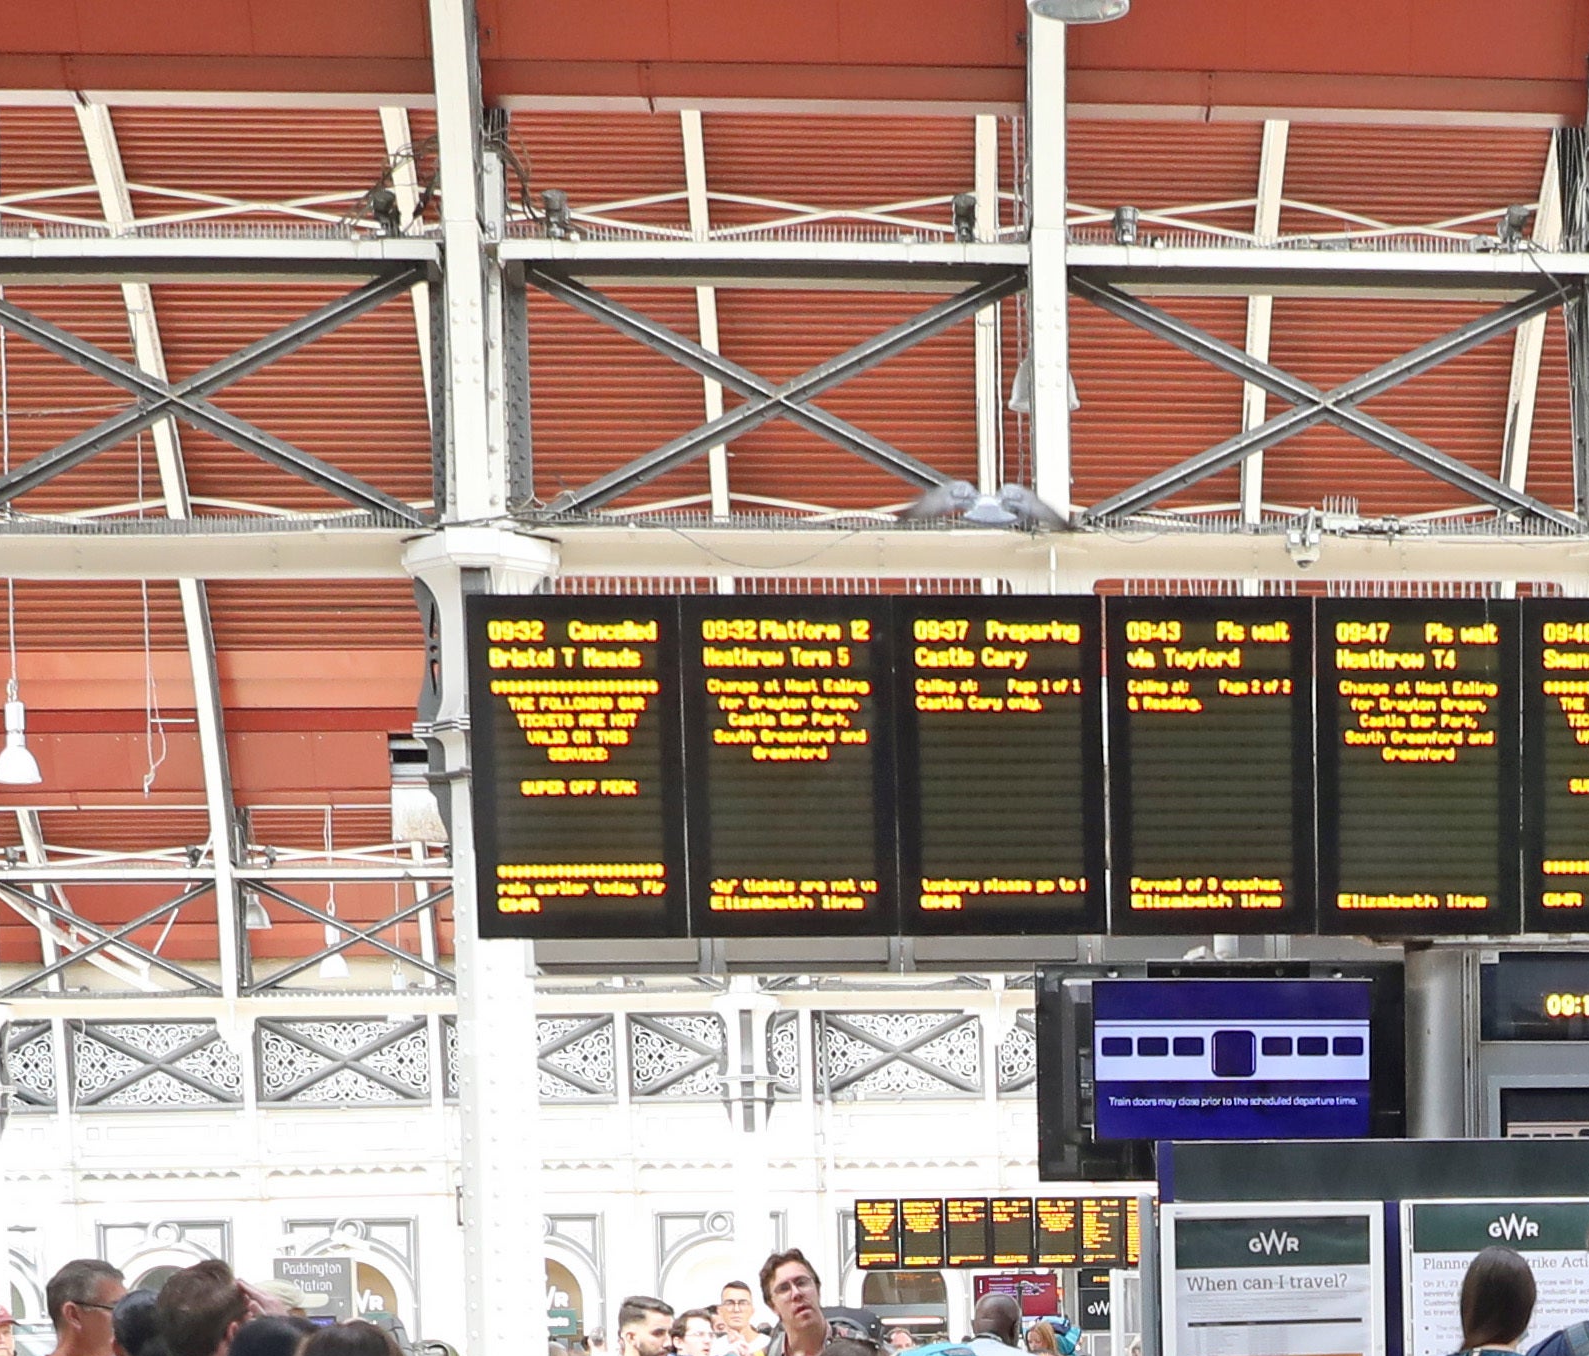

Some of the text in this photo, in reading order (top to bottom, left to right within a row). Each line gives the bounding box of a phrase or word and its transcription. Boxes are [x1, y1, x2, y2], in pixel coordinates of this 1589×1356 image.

[488, 621, 657, 642] 09:32 Cancelled
[703, 620, 870, 641] 09:32 Platform 12
[915, 621, 1080, 643] 09:37 Preparing
[1127, 622, 1290, 642] 09:43 Pls wait
[1337, 623, 1498, 644] 09:47 Pls wait
[489, 647, 641, 668] Bristol T Meads
[703, 647, 850, 667] Heathrow Term 5
[915, 647, 1028, 669] Castle Cary
[1127, 648, 1240, 669] via Twyford
[1337, 649, 1456, 669] Heathrow T4
[1108, 1096, 1359, 1108] Train doors may close prior to the scheduled departure time.
[1488, 1213, 1540, 1241] GWR
[1248, 1228, 1300, 1256] GWR
[282, 1262, 343, 1277] Paddington
[1423, 1257, 1472, 1270] Planne
[1528, 1256, 1558, 1269] trike
[294, 1279, 333, 1293] Station
[1186, 1273, 1348, 1292] When can I travel?
[1087, 1299, 1111, 1316] GW
